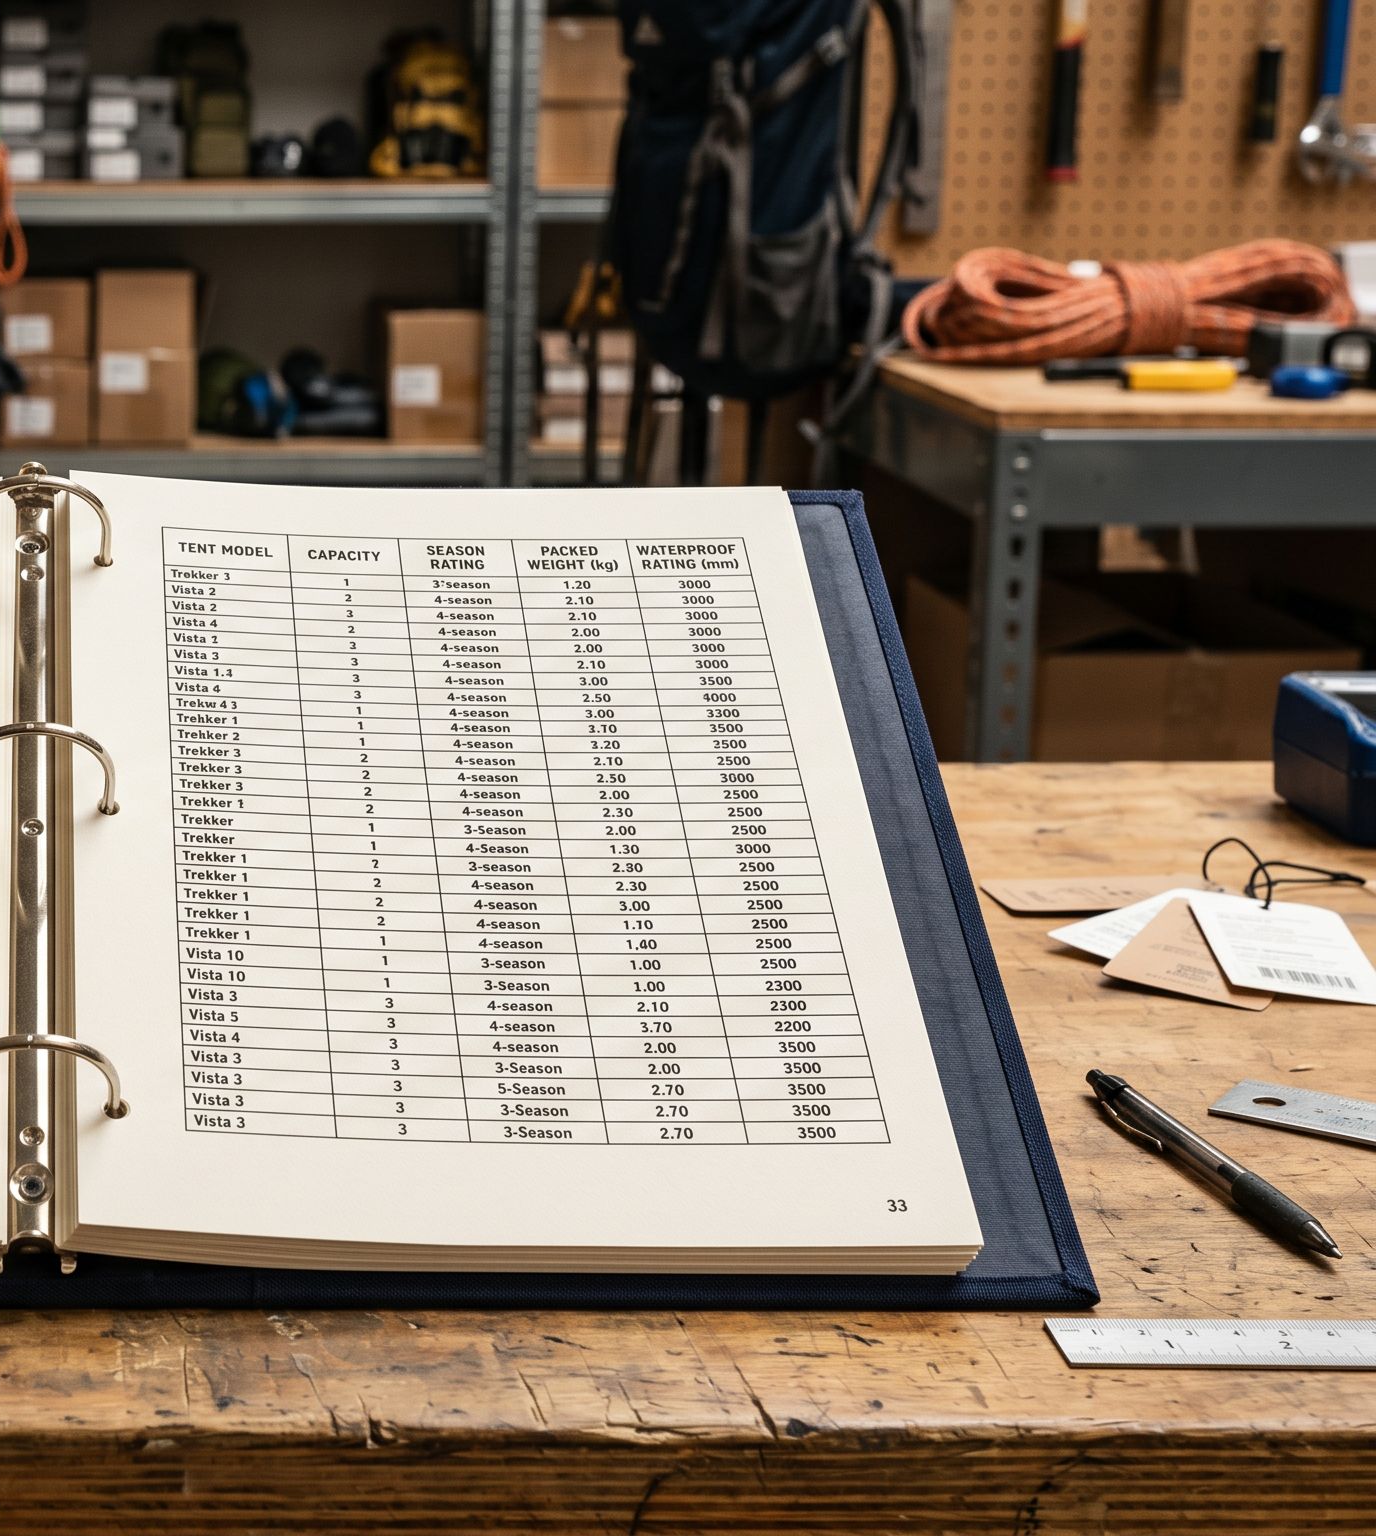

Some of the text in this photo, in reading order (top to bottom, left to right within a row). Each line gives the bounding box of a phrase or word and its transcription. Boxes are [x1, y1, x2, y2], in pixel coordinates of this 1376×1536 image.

[177, 541, 274, 558] TENT MODEL
[307, 549, 381, 562] CAPACITY
[426, 545, 485, 557] SEASON
[540, 545, 599, 557] PACKED
[635, 543, 736, 556] WATERPROOF
[430, 558, 485, 570] RATING
[526, 559, 619, 573] WEIGHT (kg)
[641, 558, 739, 570] RATING (mm)
[171, 584, 715, 606] Vista 2 2 4-season 2.10 3000
[174, 681, 737, 703] Vista 4 3 4-season 2.50 4000
[178, 778, 759, 801] Trekker 3 2 4-season 2.00 2500
[180, 813, 767, 836] Trekker 1 3-Season 2.00 2500
[181, 831, 772, 855] Trekker 1 4-Season 1.30 3000
[183, 887, 784, 912] Trekker 1 2 4-season 3.00 2500
[186, 967, 803, 993] Vista 10 1 3-Season 1.00 2300
[188, 1008, 812, 1034] Vista 5 3 4-season 3.70 2200
[190, 1070, 827, 1097] Vista 3 3 5-Season 2.70 3500
[193, 1113, 837, 1140] Vista 3 3 3-Season 2.70 3500
[886, 1198, 908, 1213] 33
[1164, 1339, 1294, 1350] 1 2
